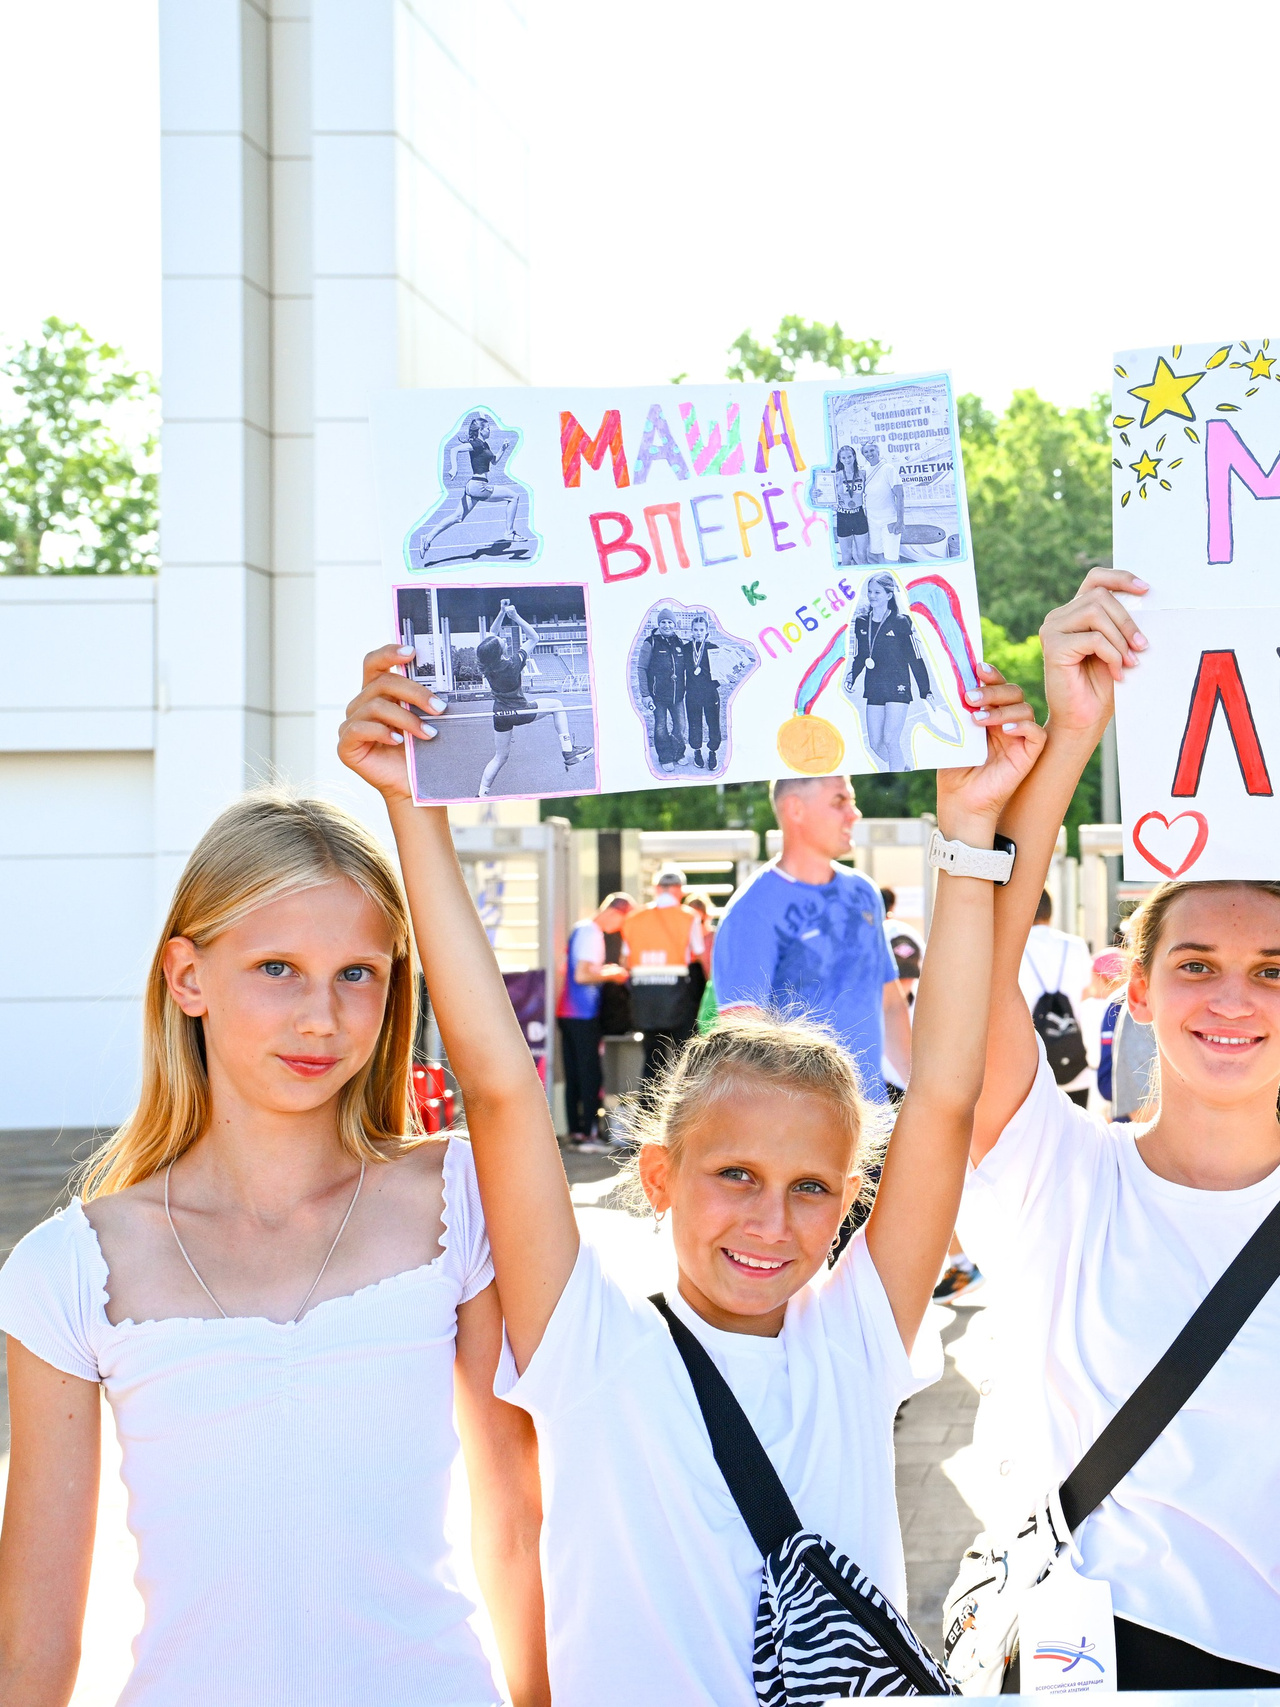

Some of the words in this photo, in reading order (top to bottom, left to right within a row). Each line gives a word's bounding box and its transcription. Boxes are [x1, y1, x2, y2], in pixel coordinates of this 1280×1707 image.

[871, 406, 922, 420] Чемпионат
[874, 418, 929, 431] первенство
[559, 390, 807, 488] МАША
[887, 442, 921, 453] Округа
[899, 461, 954, 474] АТЛЕТИК
[1035, 1681, 1076, 1692] ВСЕРОССИЙСКАЯ
